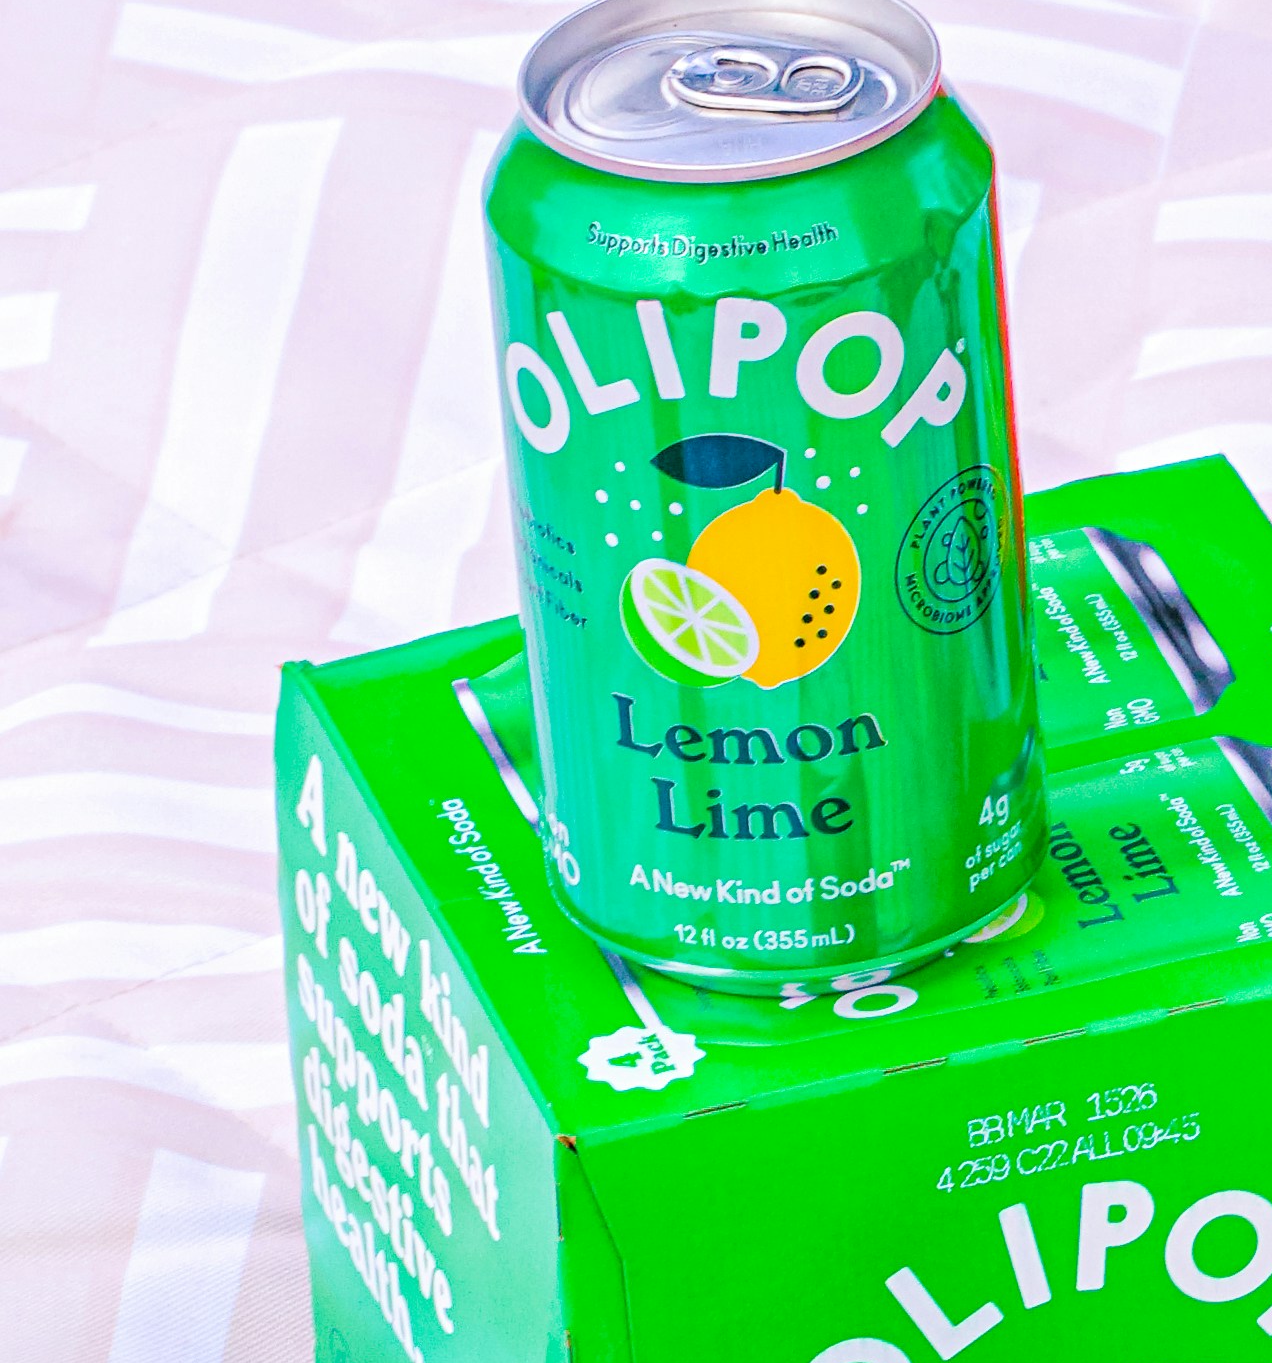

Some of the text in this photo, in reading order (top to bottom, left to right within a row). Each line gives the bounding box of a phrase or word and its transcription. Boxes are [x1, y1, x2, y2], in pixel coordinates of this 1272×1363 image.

[587, 221, 838, 265] Supports Digestive Health
[1057, 624, 1090, 652] Kind
[1080, 650, 1106, 677] New
[1088, 673, 1111, 684] A
[1104, 707, 1128, 731] Non
[1126, 697, 1160, 725] GMO
[611, 692, 888, 766] Lemon
[650, 776, 855, 841] Lime
[978, 794, 1010, 826] 4g
[454, 845, 493, 862] of
[965, 844, 982, 869] of
[1108, 822, 1179, 903] Lime
[1188, 837, 1222, 864] Kind
[466, 862, 516, 901] Kind
[629, 864, 651, 891] A
[652, 868, 713, 902] New
[716, 879, 781, 905] Kind
[786, 877, 815, 904] of
[969, 861, 996, 893] per
[1048, 821, 1125, 929] Lemon
[1212, 862, 1235, 890] New
[1220, 885, 1243, 897] A
[498, 900, 538, 941] New
[296, 754, 489, 1128] A new kind
[513, 938, 548, 954] A
[674, 924, 856, 951] 12 fl oz (355 mL)
[296, 868, 331, 958] of
[437, 1072, 501, 1241] that
[607, 1051, 643, 1068] 4
[637, 1033, 677, 1075] Pack
[297, 953, 452, 1236] supports
[303, 1046, 455, 1335] digestive
